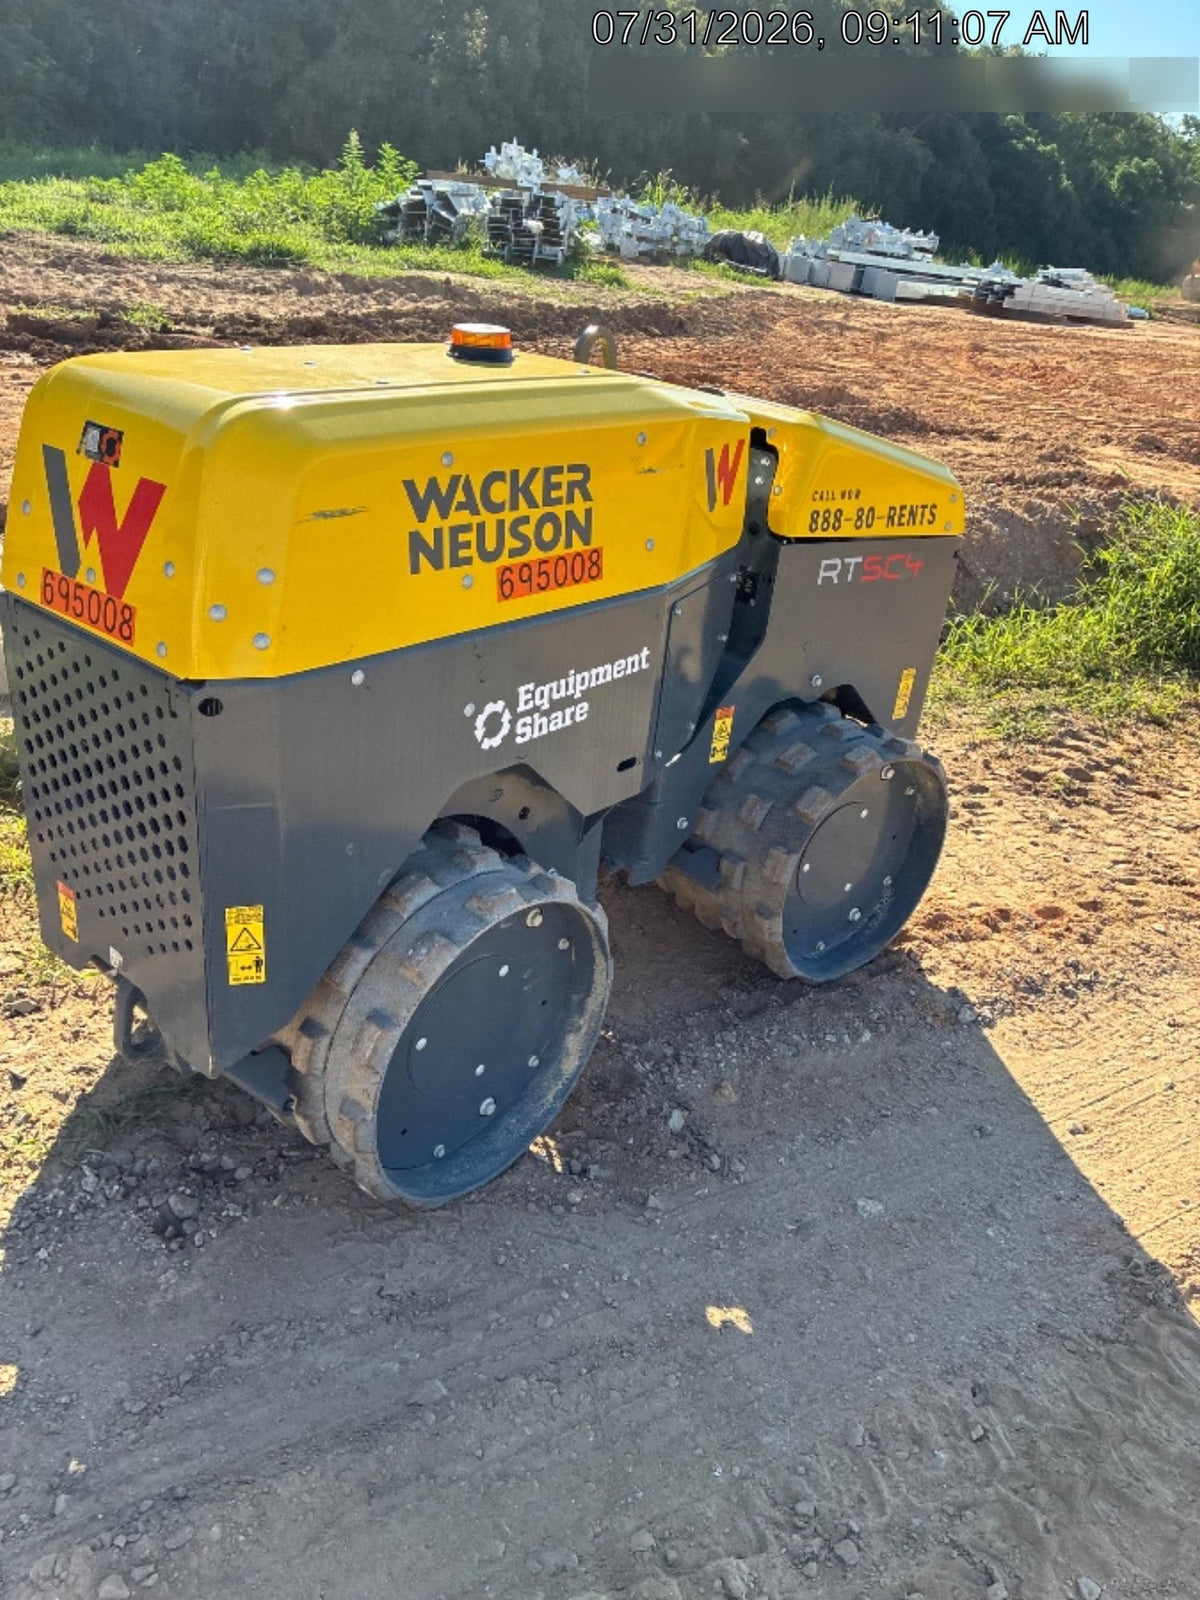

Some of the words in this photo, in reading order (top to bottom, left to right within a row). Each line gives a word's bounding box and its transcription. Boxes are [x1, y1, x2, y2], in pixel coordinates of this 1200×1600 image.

[402, 463, 594, 523] WACKER
[812, 489, 836, 502] CALL
[408, 507, 592, 575] NEUSON
[808, 503, 938, 534] 888-80-RENTS
[499, 549, 601, 599] 695008
[817, 553, 924, 585] RTSC4
[43, 569, 134, 641] 695008
[516, 646, 651, 713] Equipment
[515, 701, 590, 744] Share
